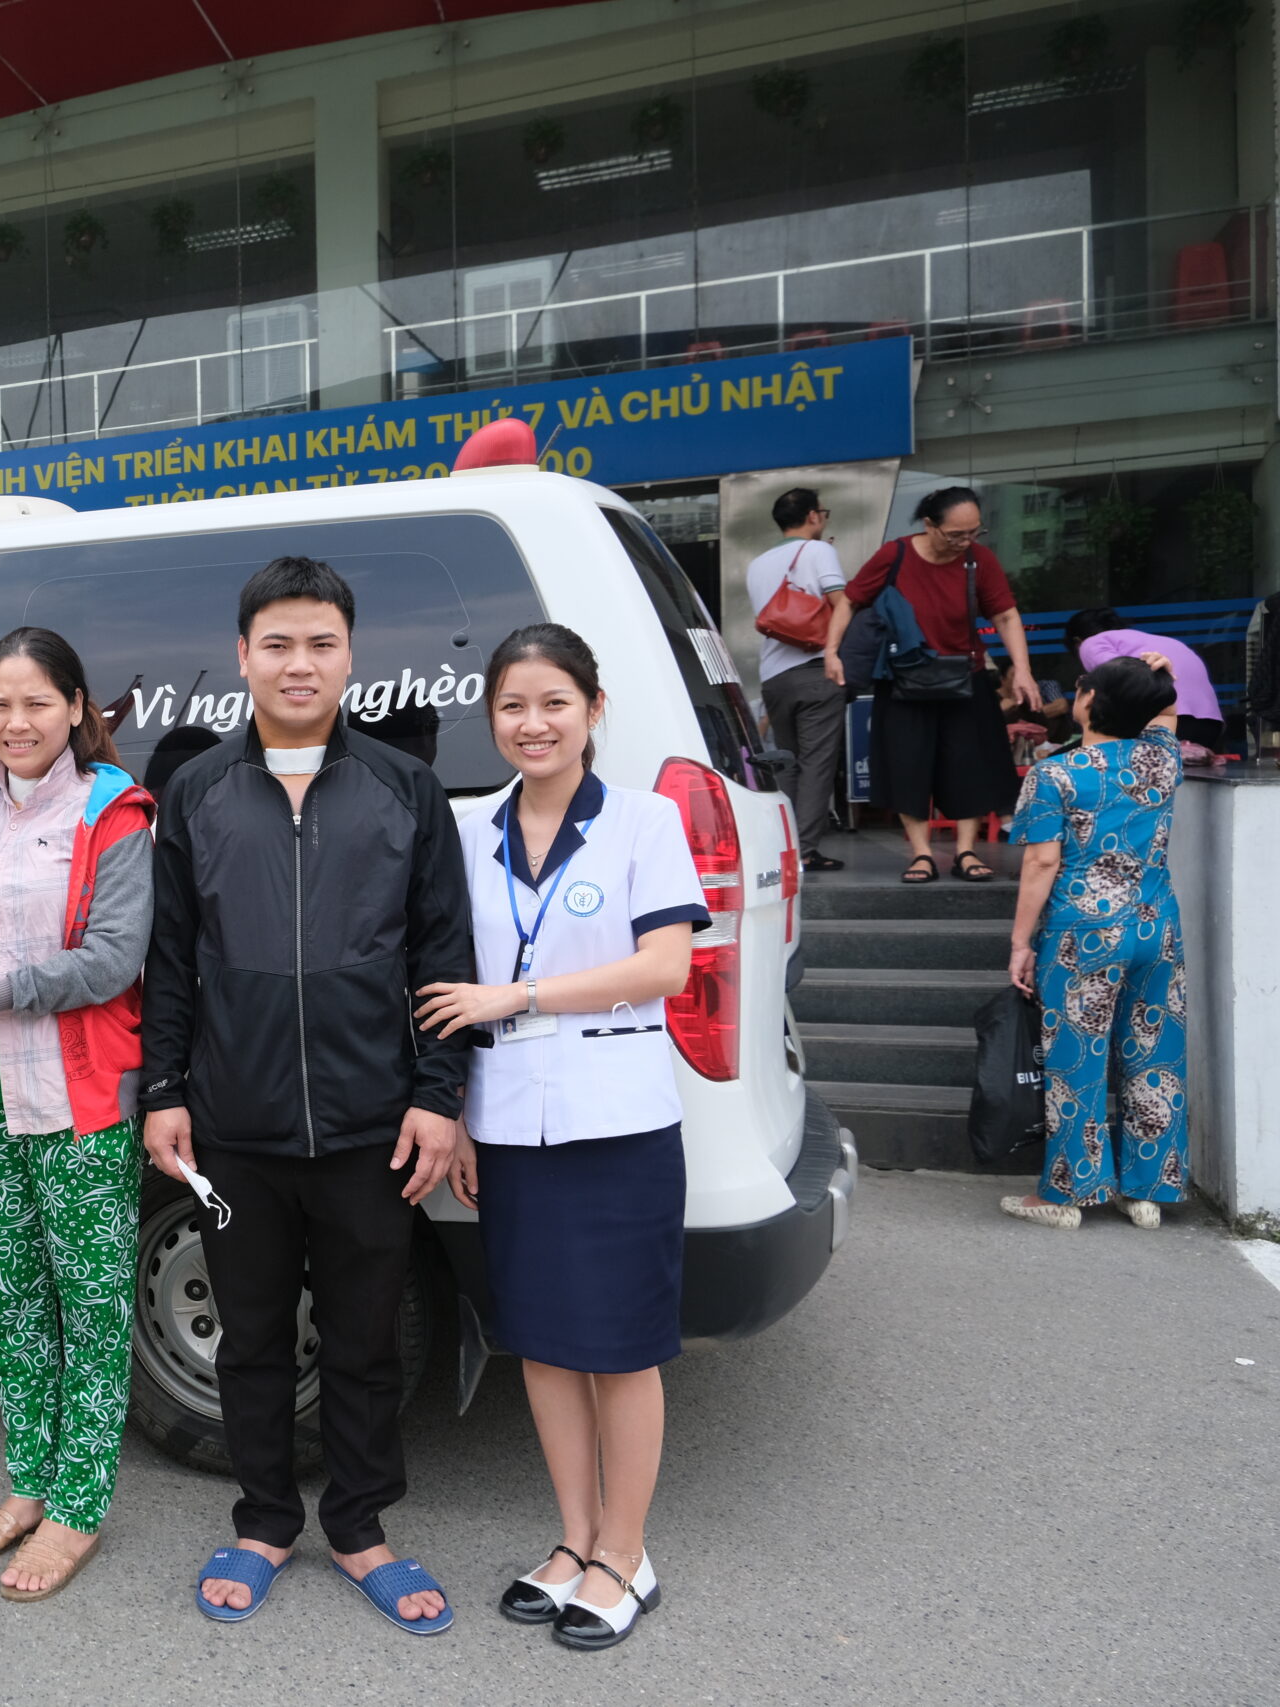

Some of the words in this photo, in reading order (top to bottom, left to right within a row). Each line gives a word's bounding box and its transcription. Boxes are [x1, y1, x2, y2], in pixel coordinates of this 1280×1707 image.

[33, 452, 105, 494] VIỆN
[112, 437, 205, 481] TRIỂN
[213, 433, 297, 469] KHAI
[306, 414, 416, 459] KHÁM
[522, 402, 545, 431] 7
[557, 387, 614, 429] VÀ
[620, 373, 710, 423] CHỦ
[721, 361, 844, 412] NHẬT
[131, 684, 176, 729] Vì
[339, 663, 485, 723] nghèo
